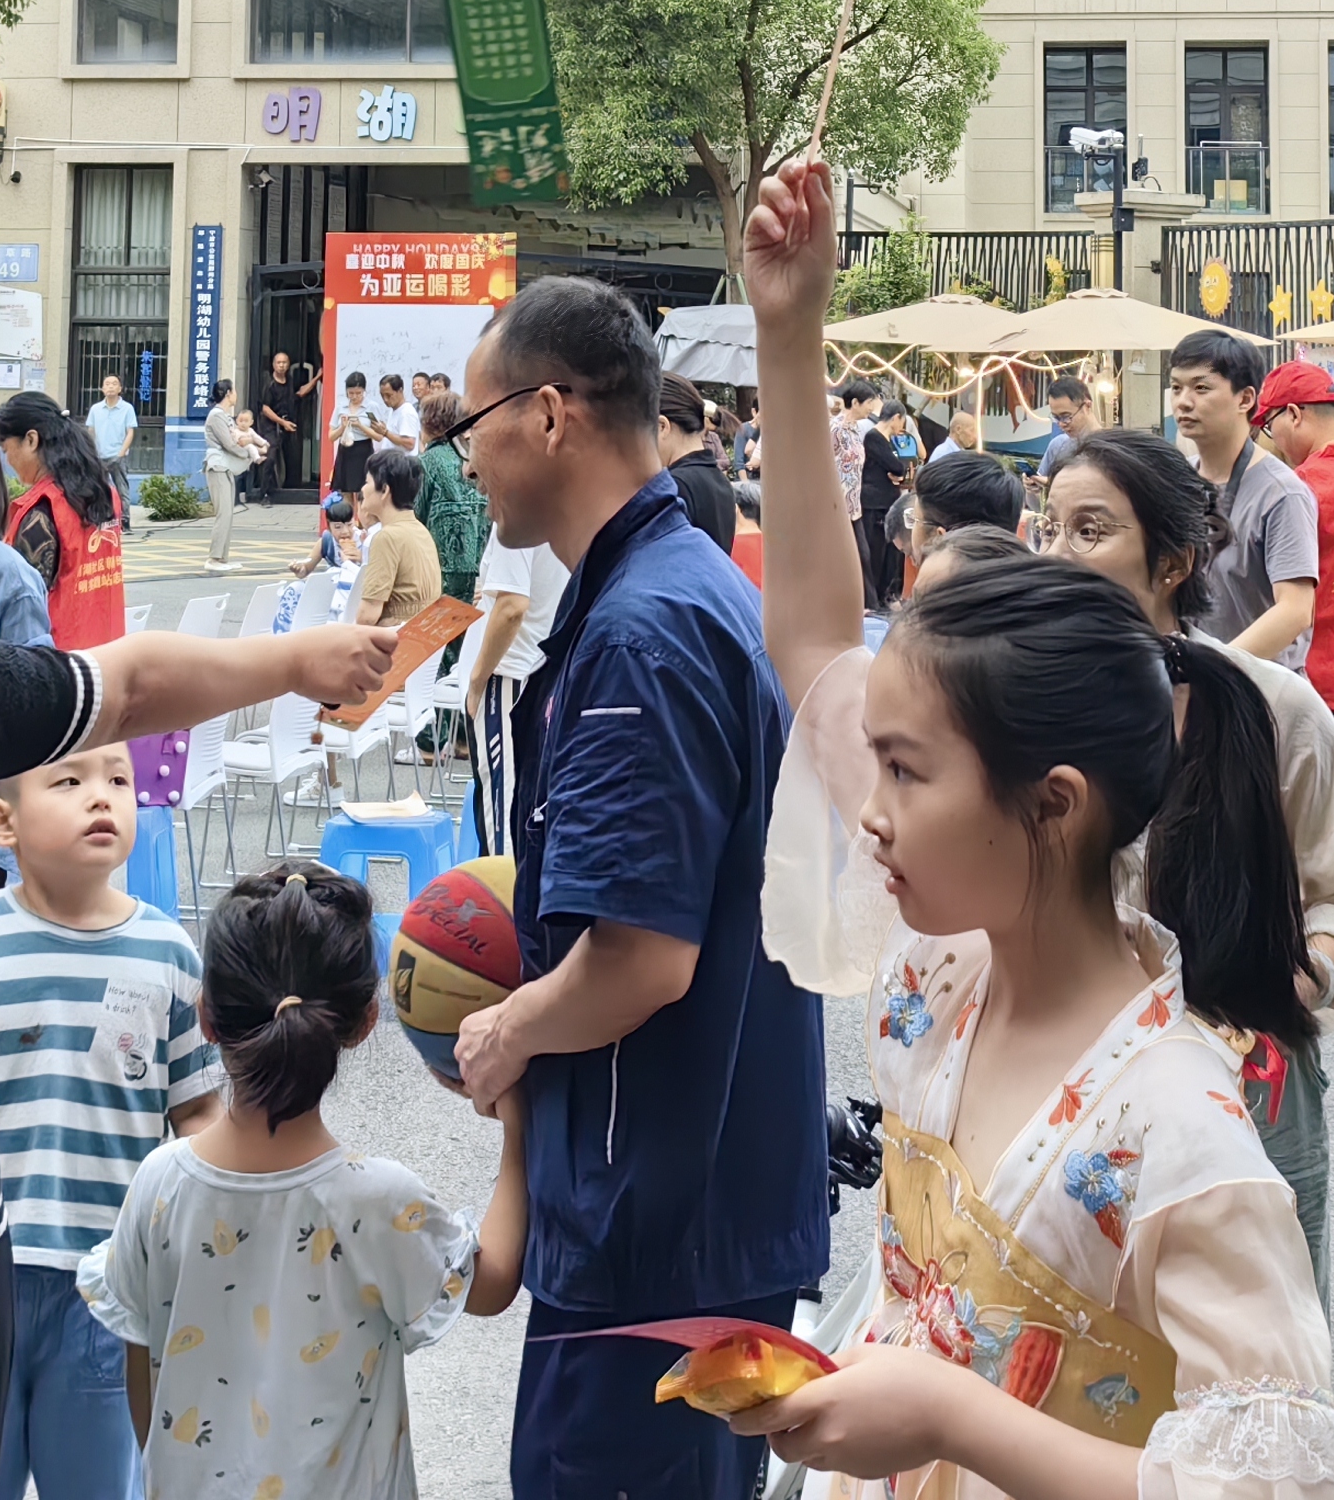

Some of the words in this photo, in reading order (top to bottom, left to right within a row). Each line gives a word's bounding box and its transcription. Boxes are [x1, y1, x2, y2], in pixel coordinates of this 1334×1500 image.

[262, 84, 418, 143] 明湖
[353, 243, 401, 254] HAPPY
[345, 253, 406, 270] 喜迎中秋
[424, 253, 486, 270] 欢度国庆
[359, 273, 471, 297] 为亚运喝彩
[192, 292, 213, 409] 明湖幼儿园警务联络点
[108, 986, 126, 997] How
[112, 1003, 137, 1016] drink?
